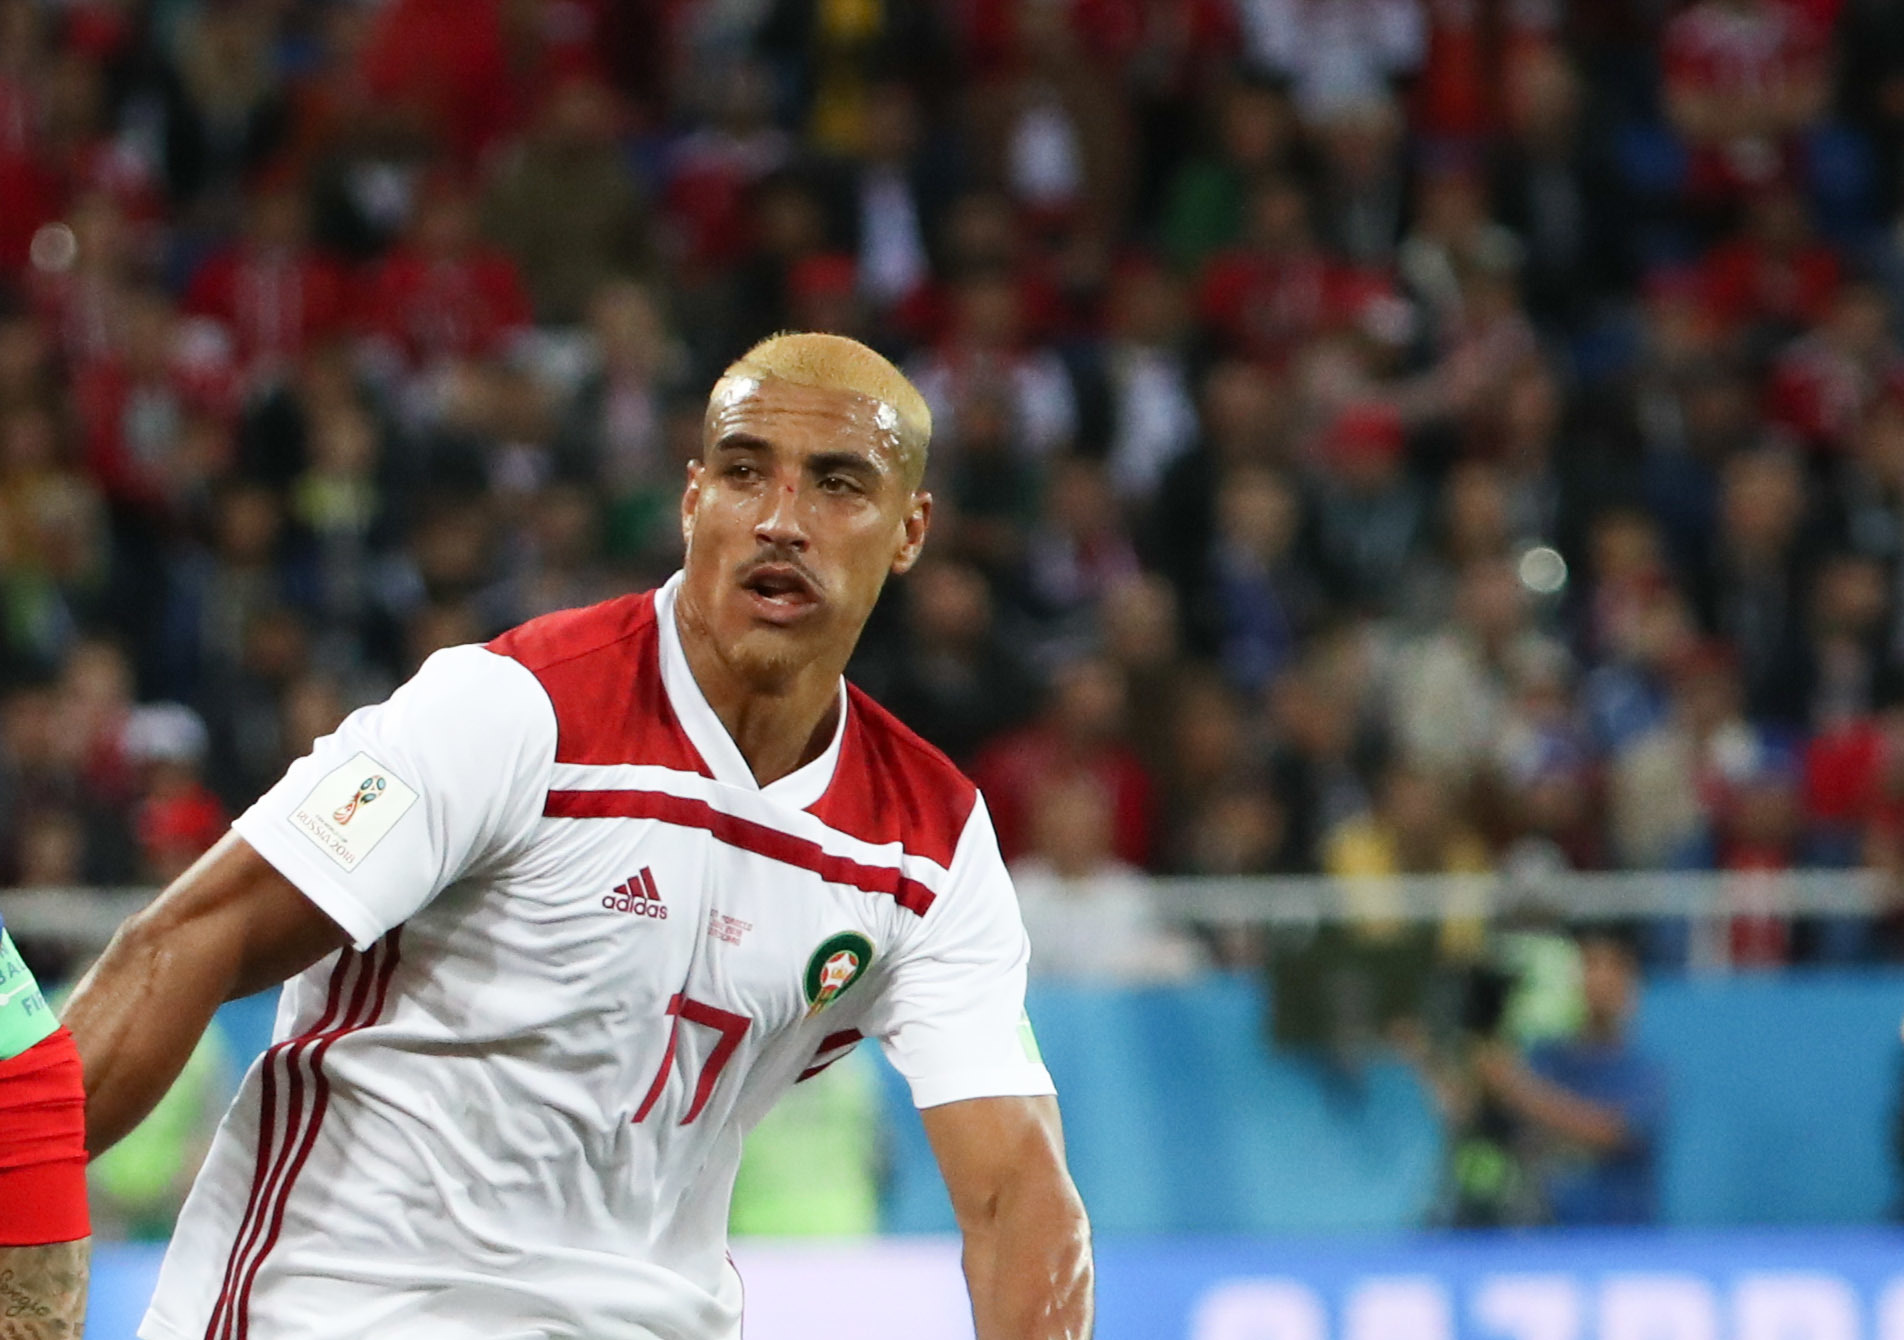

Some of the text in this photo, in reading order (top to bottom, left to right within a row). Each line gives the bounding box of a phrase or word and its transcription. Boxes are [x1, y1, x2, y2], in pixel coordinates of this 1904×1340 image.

[295, 810, 332, 844] RUSSIA
[329, 839, 357, 864] 2018
[602, 894, 668, 920] adidas
[630, 993, 753, 1126] 17
